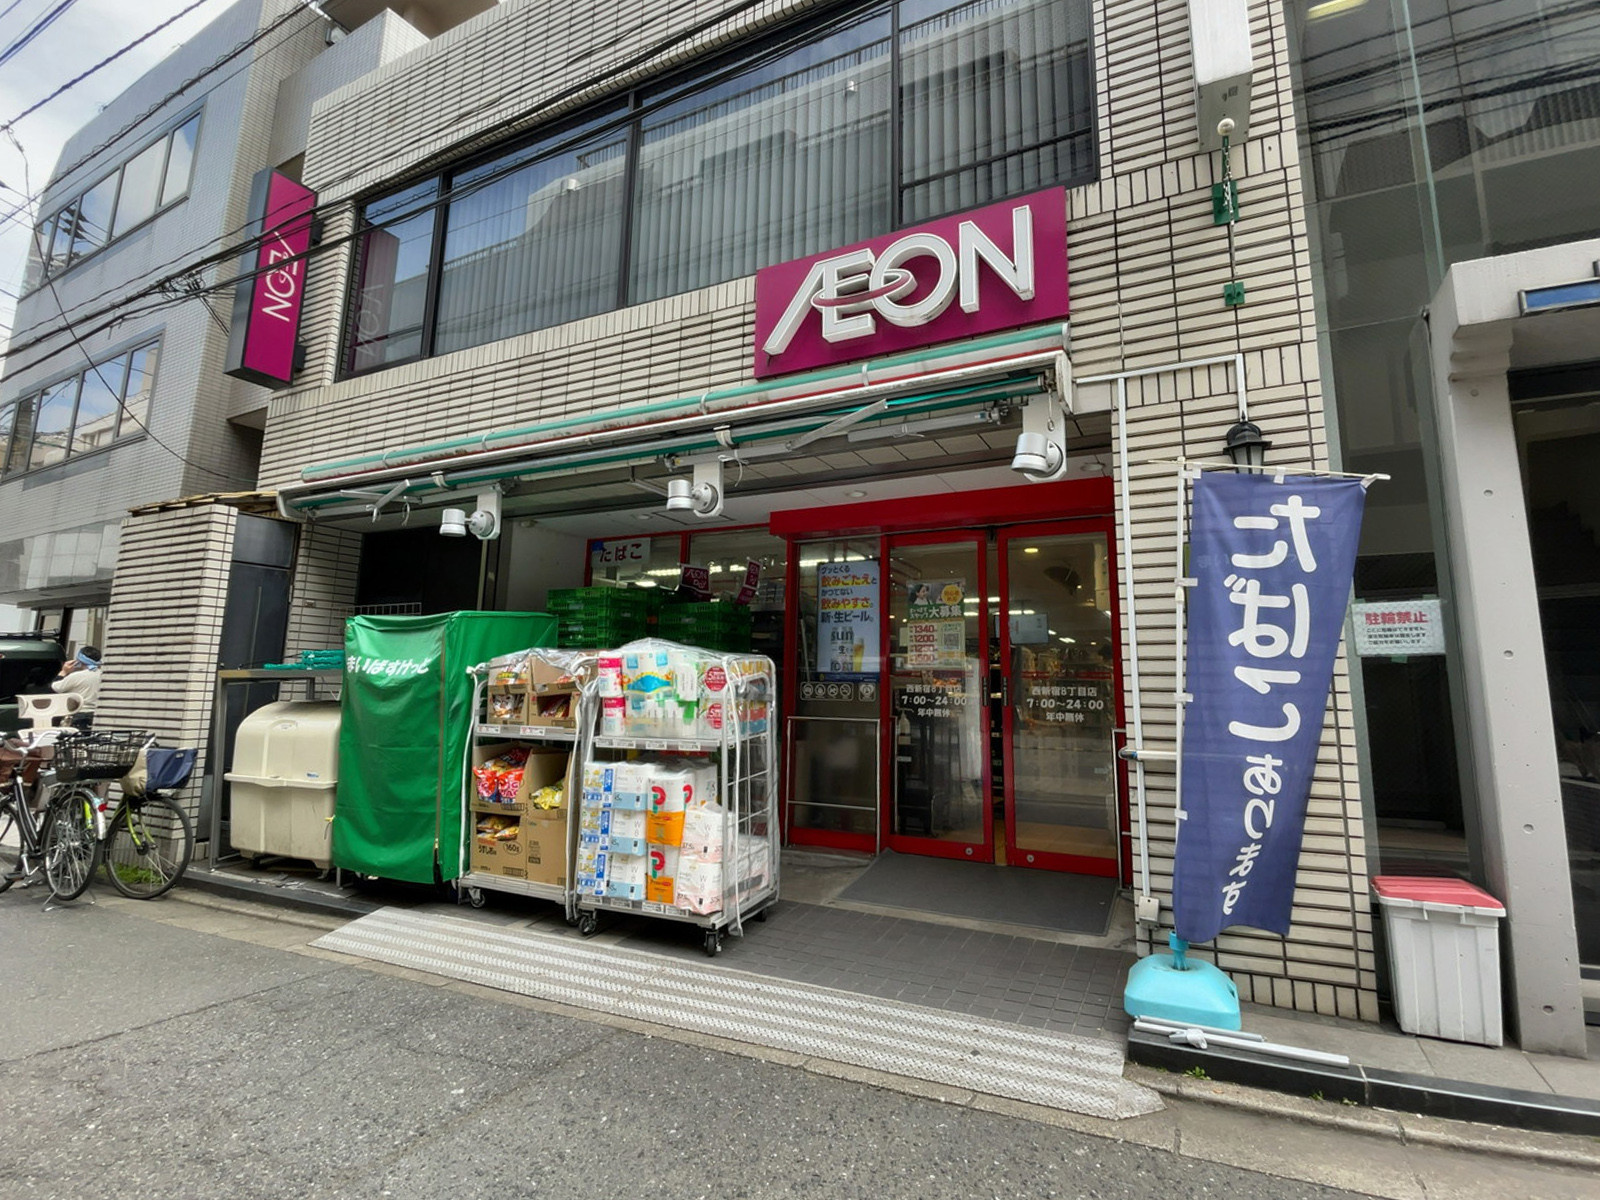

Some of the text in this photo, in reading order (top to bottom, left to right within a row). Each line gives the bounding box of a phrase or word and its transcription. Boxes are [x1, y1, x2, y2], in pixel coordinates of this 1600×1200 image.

[600, 543, 643, 562] たばこ
[821, 565, 850, 574] グッとくる
[821, 574, 877, 587] 飲みごたえと
[821, 588, 853, 597] かつてない
[929, 605, 962, 618] 大募集
[1365, 611, 1428, 625] 駐輪禁止
[347, 655, 432, 676] まいばすけっと
[906, 684, 962, 694] 西新宿8丁目店
[1032, 685, 1098, 697] 西新宿8丁目店
[917, 708, 950, 718] 年中無休
[1045, 711, 1085, 722] 年中無休
